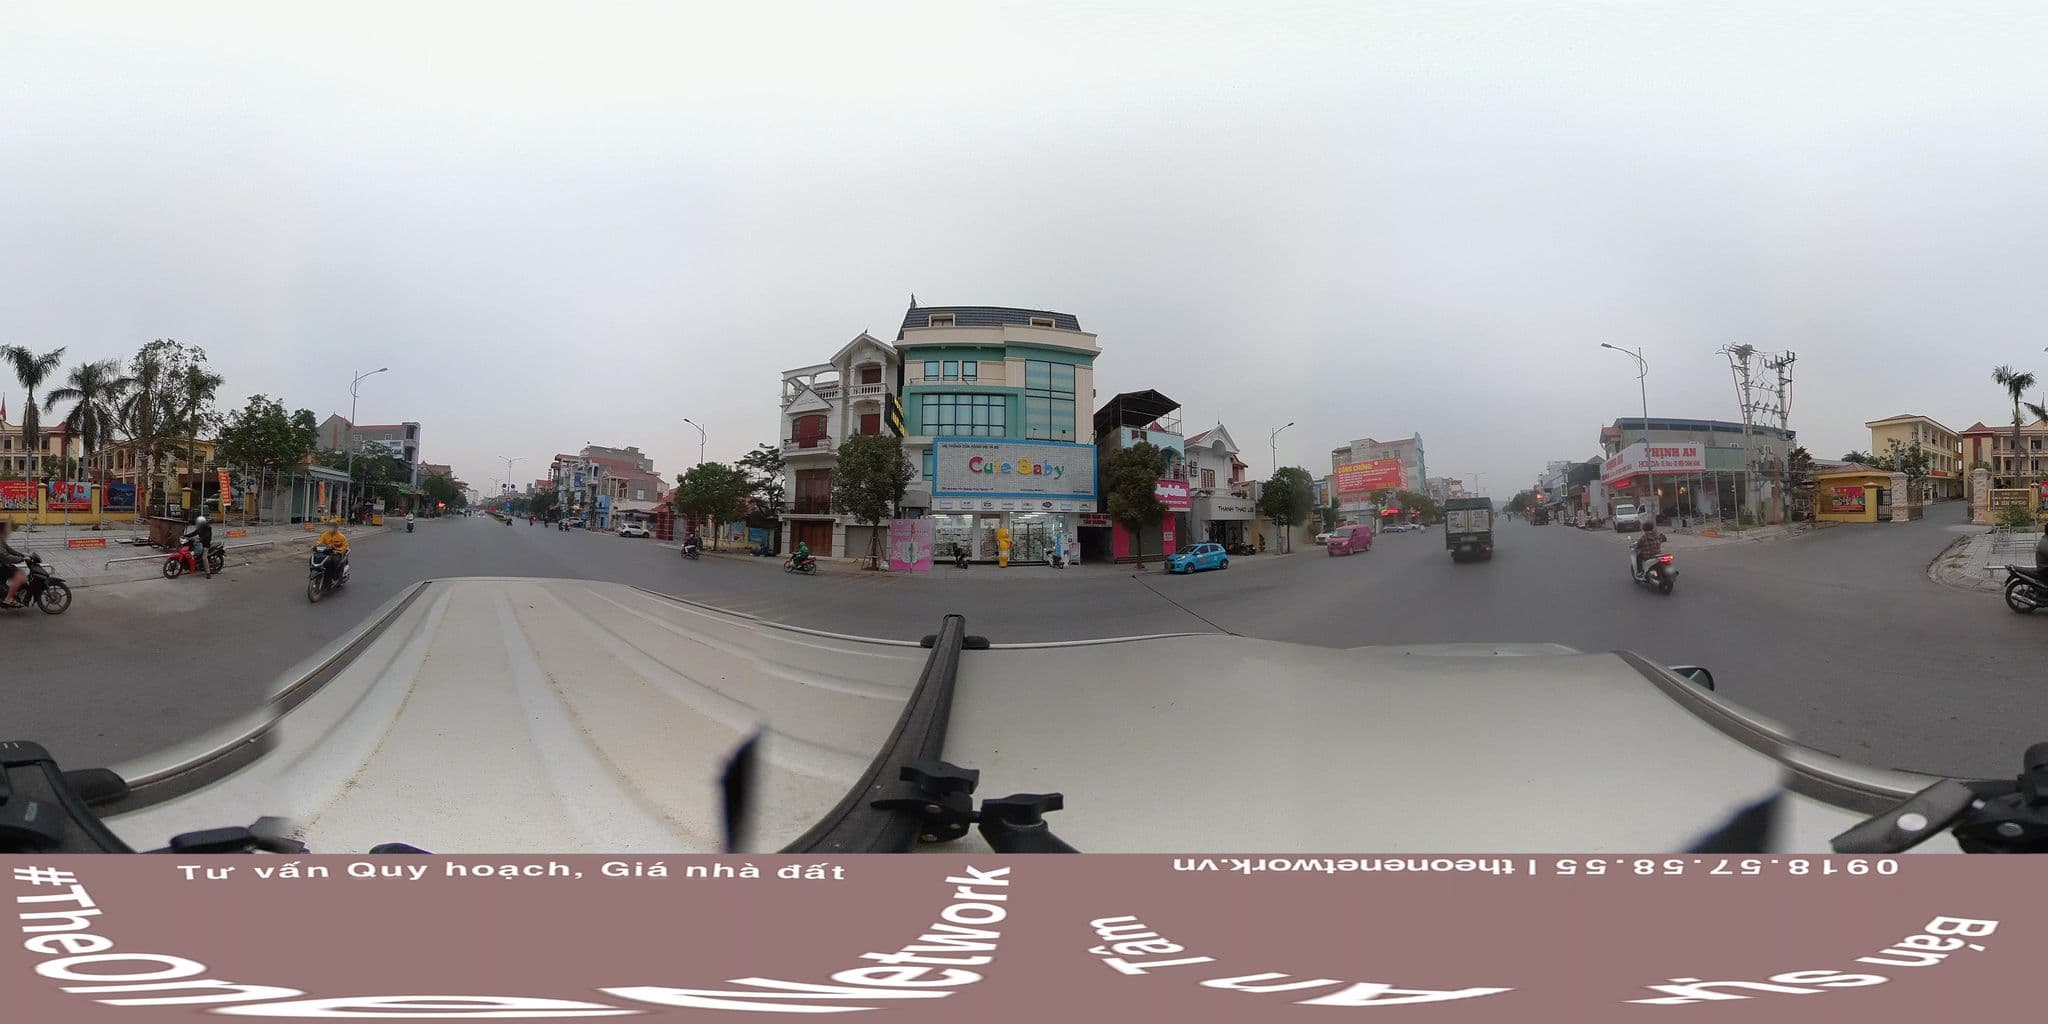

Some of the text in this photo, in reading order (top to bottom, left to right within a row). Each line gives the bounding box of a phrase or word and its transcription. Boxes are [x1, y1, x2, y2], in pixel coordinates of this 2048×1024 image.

[1683, 447, 1697, 457] AN
[968, 456, 1065, 481] Cute Baby
